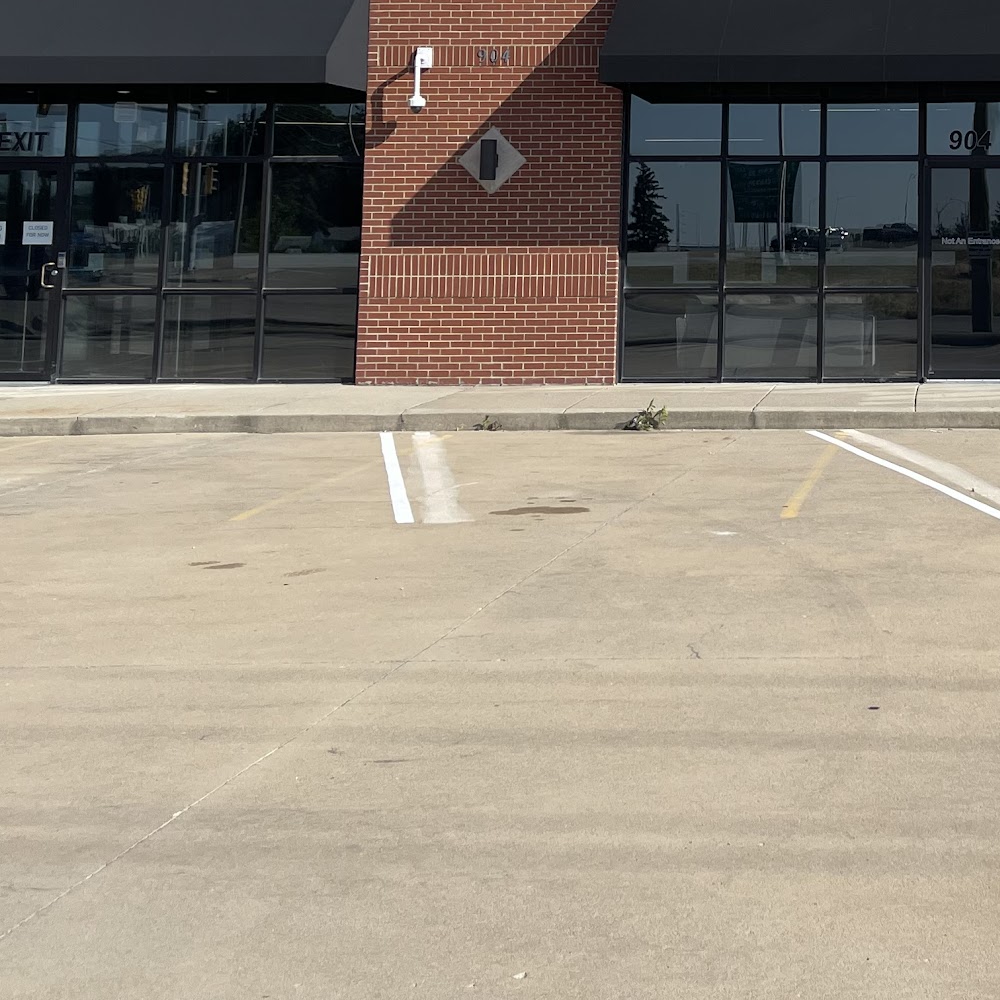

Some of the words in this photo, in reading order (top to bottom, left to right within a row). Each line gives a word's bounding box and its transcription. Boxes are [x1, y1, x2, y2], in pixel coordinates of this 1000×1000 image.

[476, 47, 511, 65] 904
[0, 131, 49, 152] EXIT
[949, 130, 992, 151] 904
